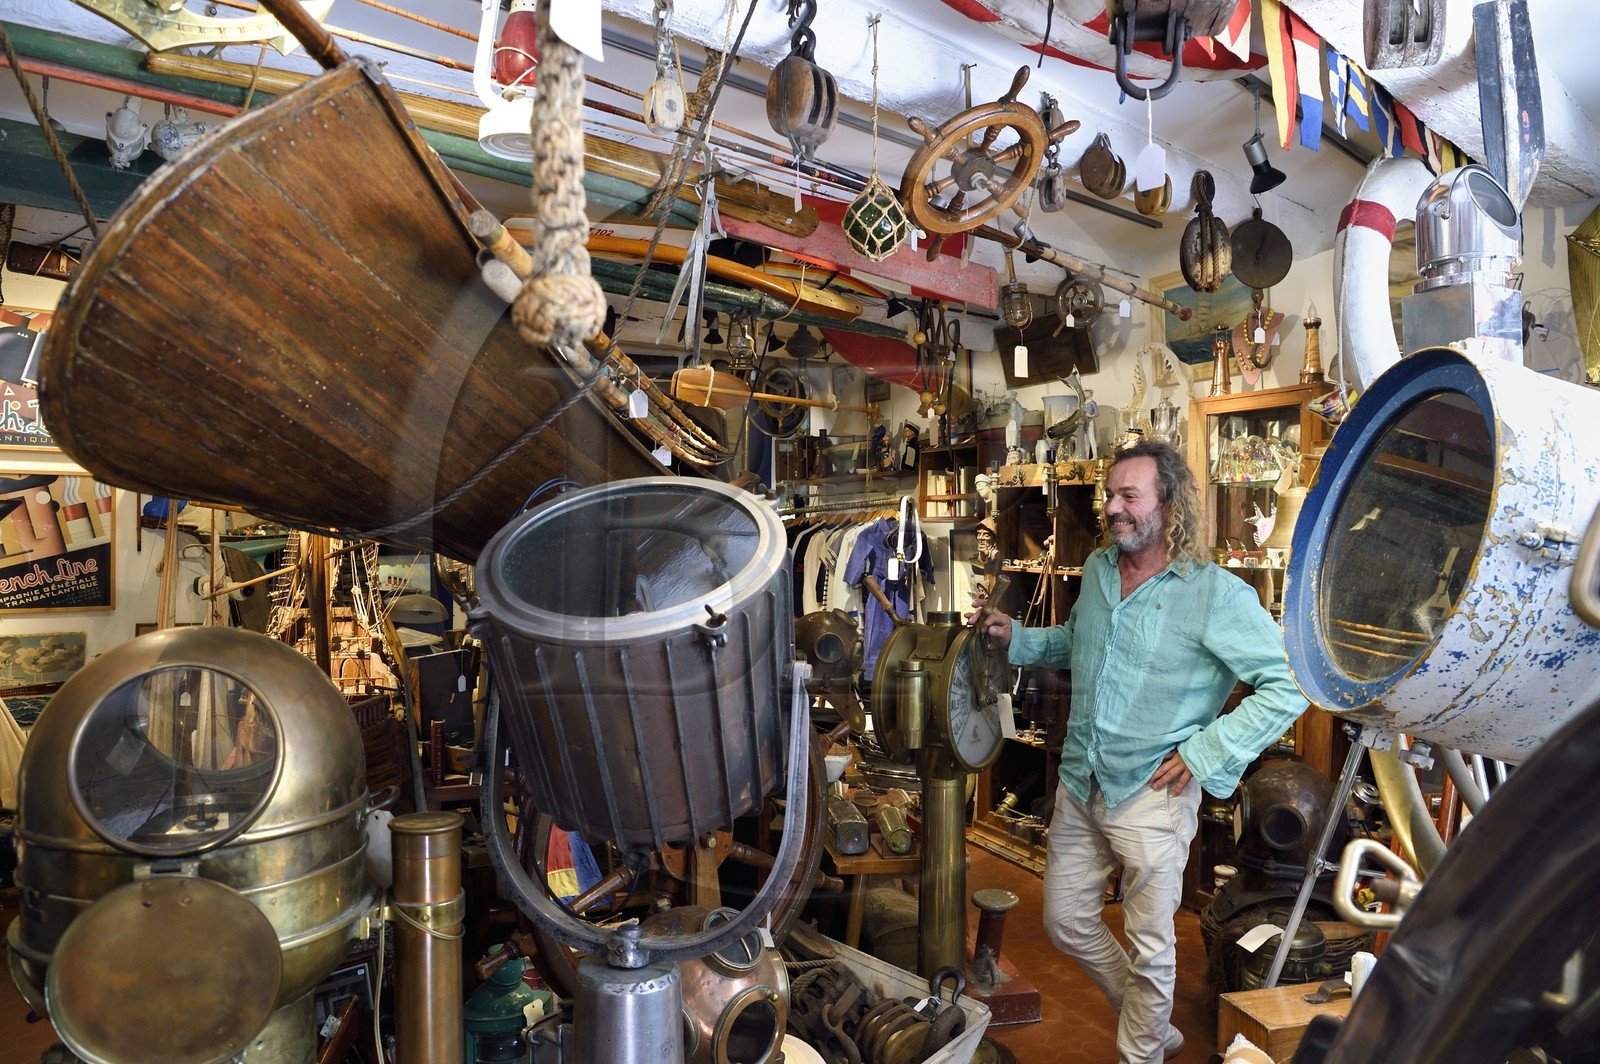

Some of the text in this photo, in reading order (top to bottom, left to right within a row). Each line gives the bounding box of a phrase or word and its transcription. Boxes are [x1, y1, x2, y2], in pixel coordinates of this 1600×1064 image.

[0, 435, 56, 443] NTIQU
[53, 558, 98, 582] Line
[4, 581, 98, 608] TRANSATLANTIQUE
